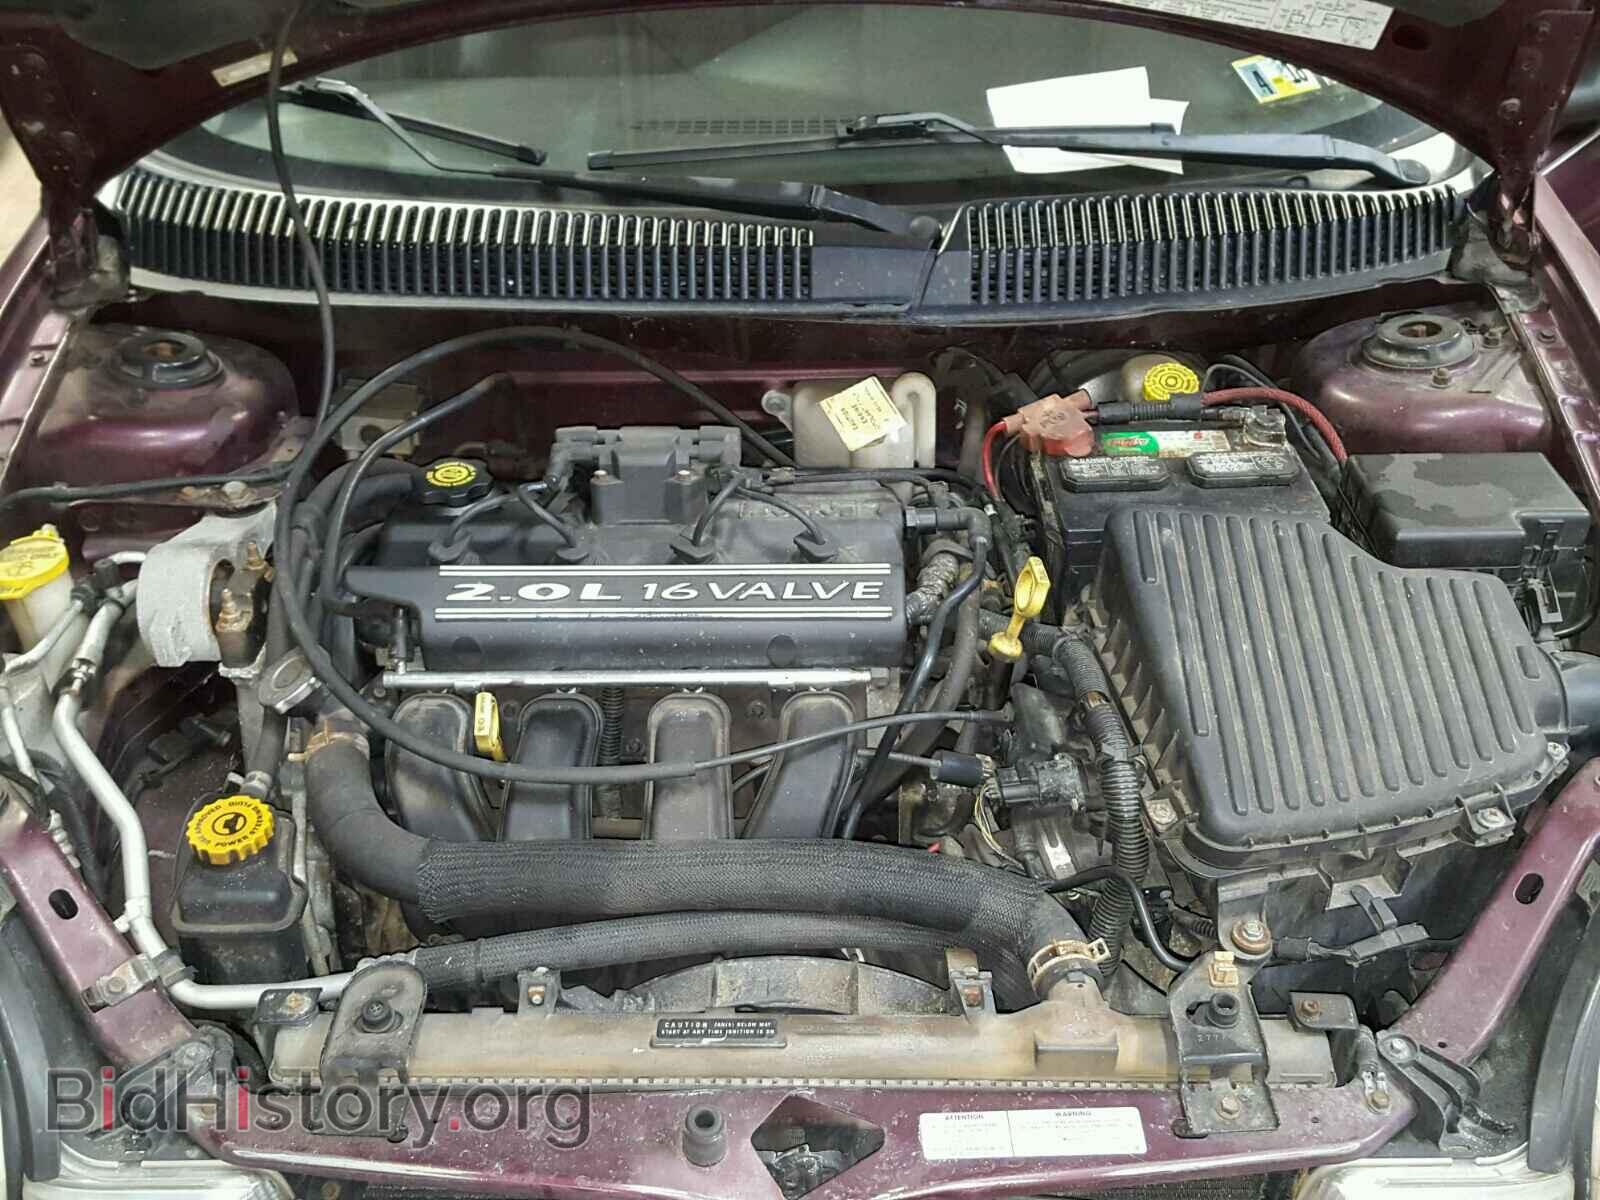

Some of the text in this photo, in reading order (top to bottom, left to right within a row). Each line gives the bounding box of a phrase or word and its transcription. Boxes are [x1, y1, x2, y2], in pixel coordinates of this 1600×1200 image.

[445, 581, 884, 601] 2.0L 16 VALVE
[214, 835, 249, 847] POWER
